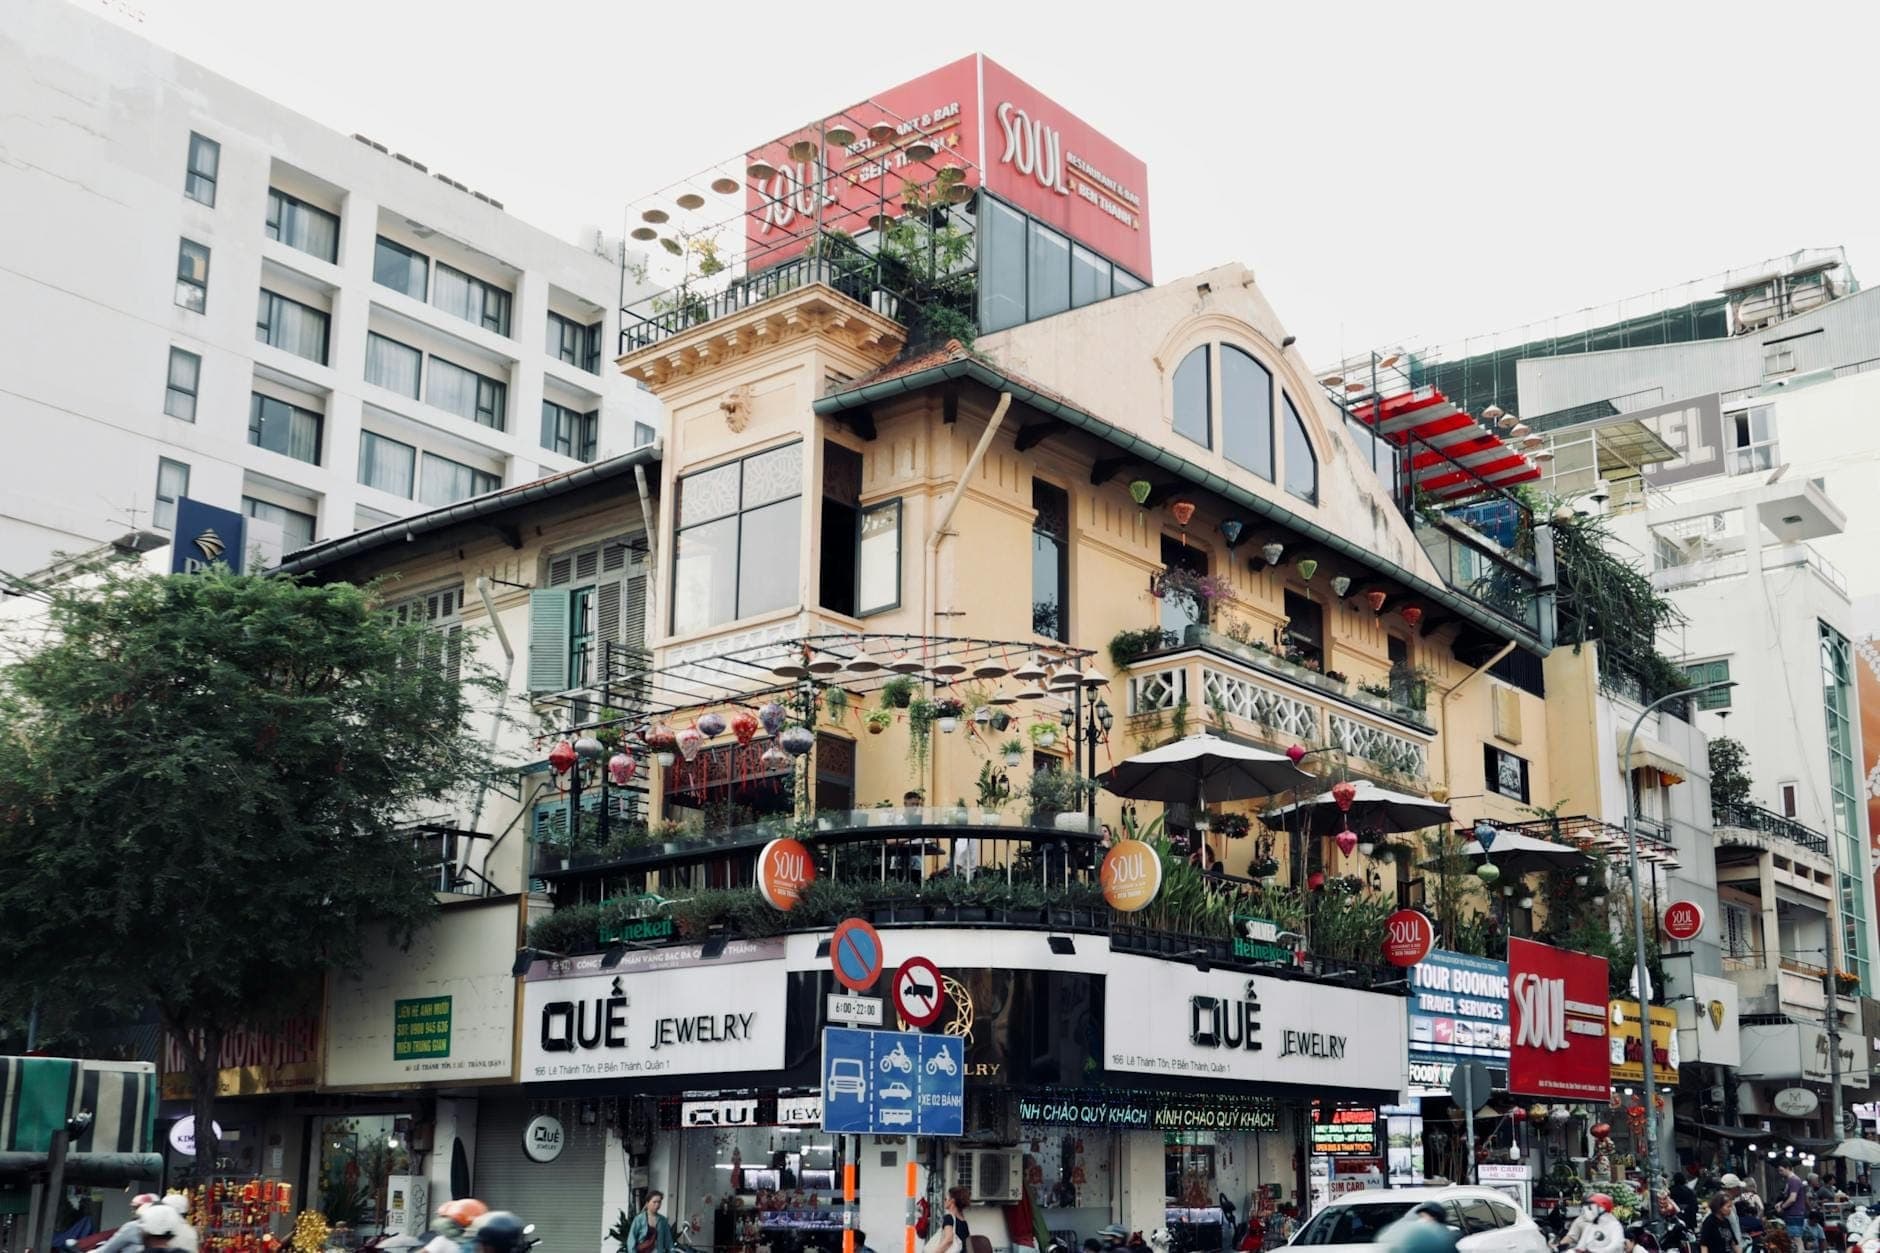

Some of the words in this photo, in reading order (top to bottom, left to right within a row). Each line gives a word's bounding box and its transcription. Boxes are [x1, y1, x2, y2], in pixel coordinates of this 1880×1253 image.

[921, 114, 931, 127] &
[934, 102, 960, 121] BAR
[997, 102, 1070, 196] SOUL
[773, 850, 805, 882] SOUL
[1110, 852, 1147, 885] SOUL
[1671, 910, 1693, 924] SOUL
[1389, 919, 1422, 944] SOUL
[1233, 937, 1291, 962] Heineken
[1414, 962, 1450, 992] TOUR
[1451, 968, 1510, 1000] BOOKING
[1420, 993, 1456, 1014] TRAVEL
[1458, 997, 1504, 1020] SERVICES
[1513, 972, 1570, 1052] SOUL
[650, 1011, 755, 1050] JEWELRY
[1277, 1028, 1348, 1060] JEWELRY
[964, 1063, 1001, 1075] LRY
[921, 1094, 931, 1105] XE
[931, 1095, 940, 1106] 02
[942, 1092, 962, 1107] BÁNH
[1020, 1099, 1041, 1120] ÍNH
[1043, 1100, 1079, 1123] CHÀO
[1080, 1102, 1107, 1124] QUÝ
[1108, 1103, 1148, 1125] KHÁCH
[689, 1108, 758, 1125] QU
[784, 1107, 822, 1122] JEW
[1155, 1104, 1184, 1126] KÍNH
[1184, 1105, 1215, 1127] CHÀO
[1216, 1107, 1239, 1127] QUÝ
[1239, 1108, 1275, 1128] KHÁCH
[1330, 1181, 1345, 1193] SIM
[1346, 1181, 1366, 1193] CARD
